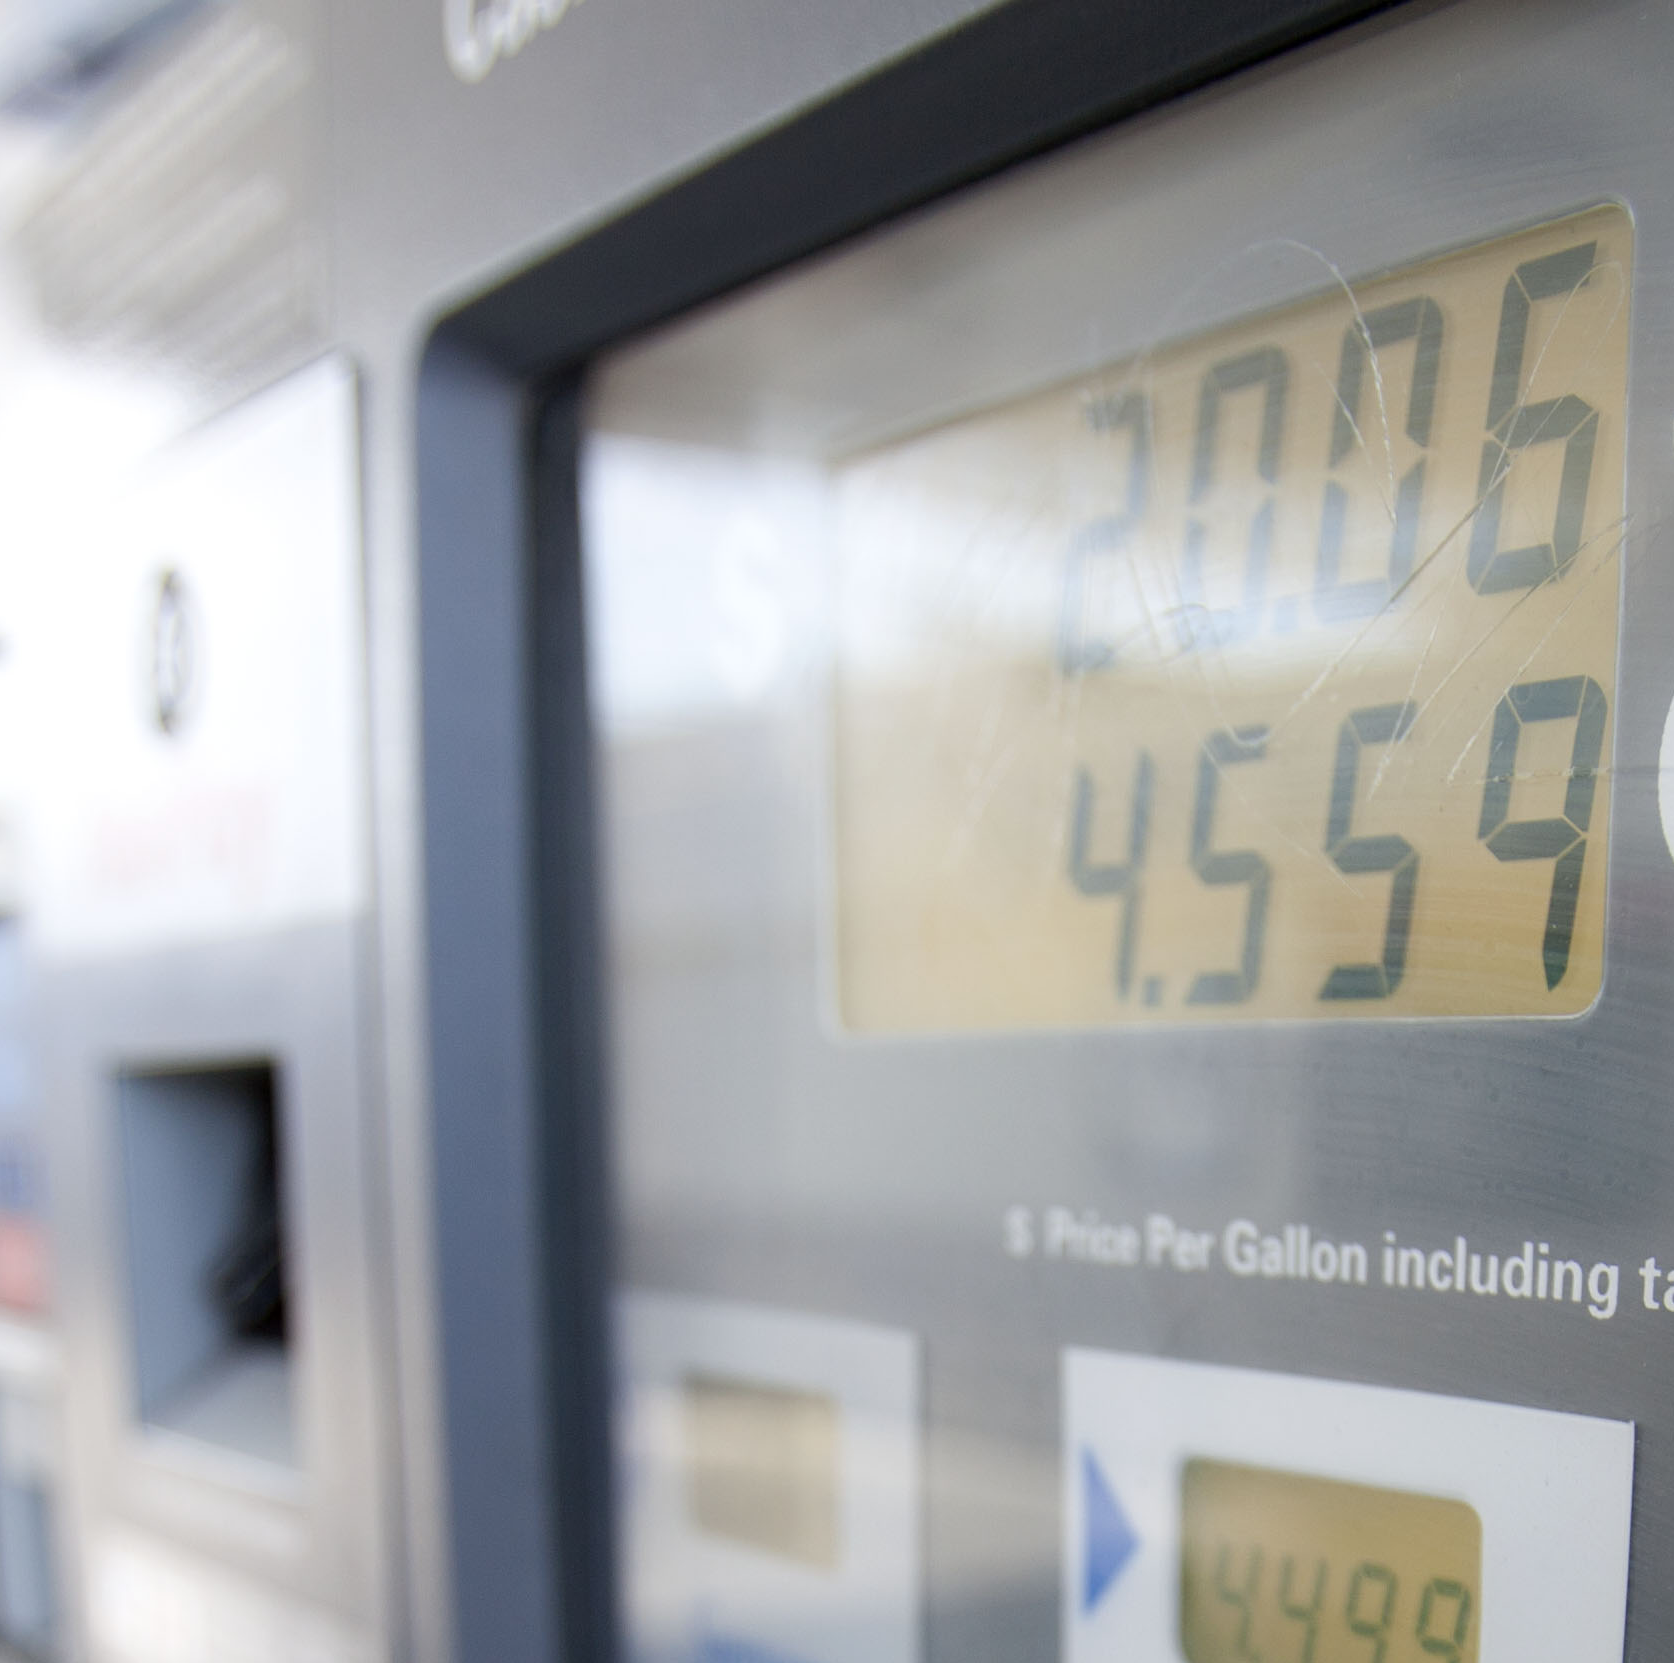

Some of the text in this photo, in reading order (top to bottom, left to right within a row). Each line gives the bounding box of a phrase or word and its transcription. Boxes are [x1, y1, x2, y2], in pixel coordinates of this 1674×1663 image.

[1067, 674, 1610, 1008] 4.559
[1004, 1207, 1033, 1260] $
[1041, 1209, 1139, 1267] Price
[1146, 1214, 1216, 1272] Per
[1223, 1219, 1369, 1286] Gallon
[1382, 1231, 1621, 1321] including
